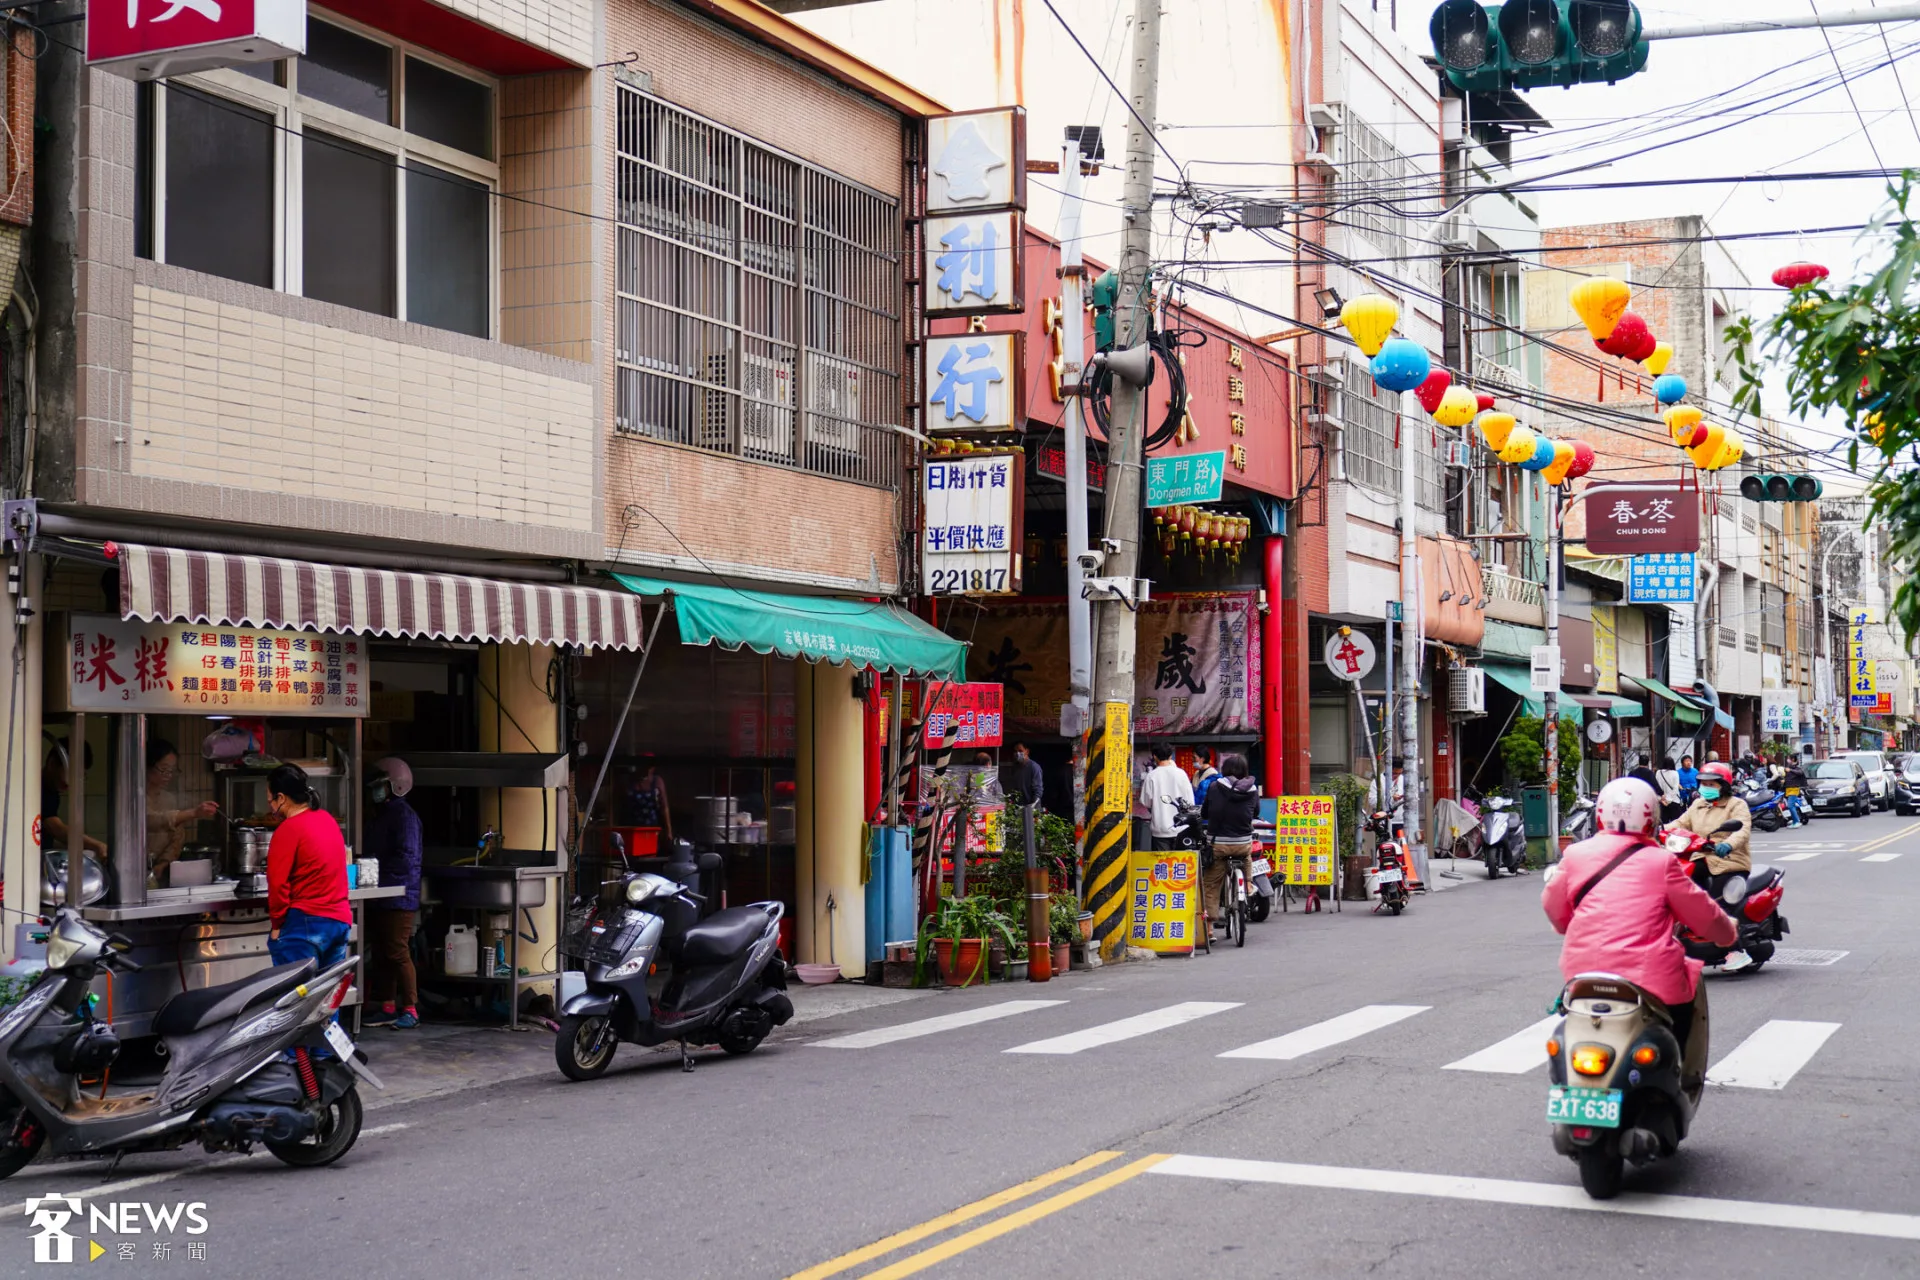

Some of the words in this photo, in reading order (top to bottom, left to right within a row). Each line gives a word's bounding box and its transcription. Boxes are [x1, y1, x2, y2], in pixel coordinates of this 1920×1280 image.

[928, 463, 1007, 491] 日用什貨
[1148, 486, 1191, 502] Dongmen
[1194, 482, 1209, 496] Rd.
[1150, 458, 1210, 486] 東門路
[928, 525, 1005, 551] 平價供應
[1642, 527, 1666, 535] DONG
[931, 568, 1007, 592] 221817
[1633, 576, 1691, 587] 甘梅薯條
[1633, 588, 1691, 599] 現炸香雞排
[86, 632, 174, 693] 米糕
[181, 631, 199, 691] 乾麵
[201, 632, 218, 692] 担仔麵
[220, 633, 237, 692] 陽春麵
[238, 634, 256, 694] 苦瓜排骨
[257, 635, 273, 694] 金針排骨
[292, 637, 308, 695] 冬菜鴨
[309, 638, 325, 695] 貢丸湯
[326, 640, 342, 696] 油豆腐湯
[311, 695, 324, 706] 20
[345, 696, 358, 707] 30
[1279, 799, 1332, 816] 永安宮廟口
[1132, 867, 1150, 939] 一口臭豆腐
[1151, 863, 1168, 939] 鴨肉飯
[1170, 863, 1187, 938] 担蛋麵
[1593, 984, 1618, 994] YAMAHA
